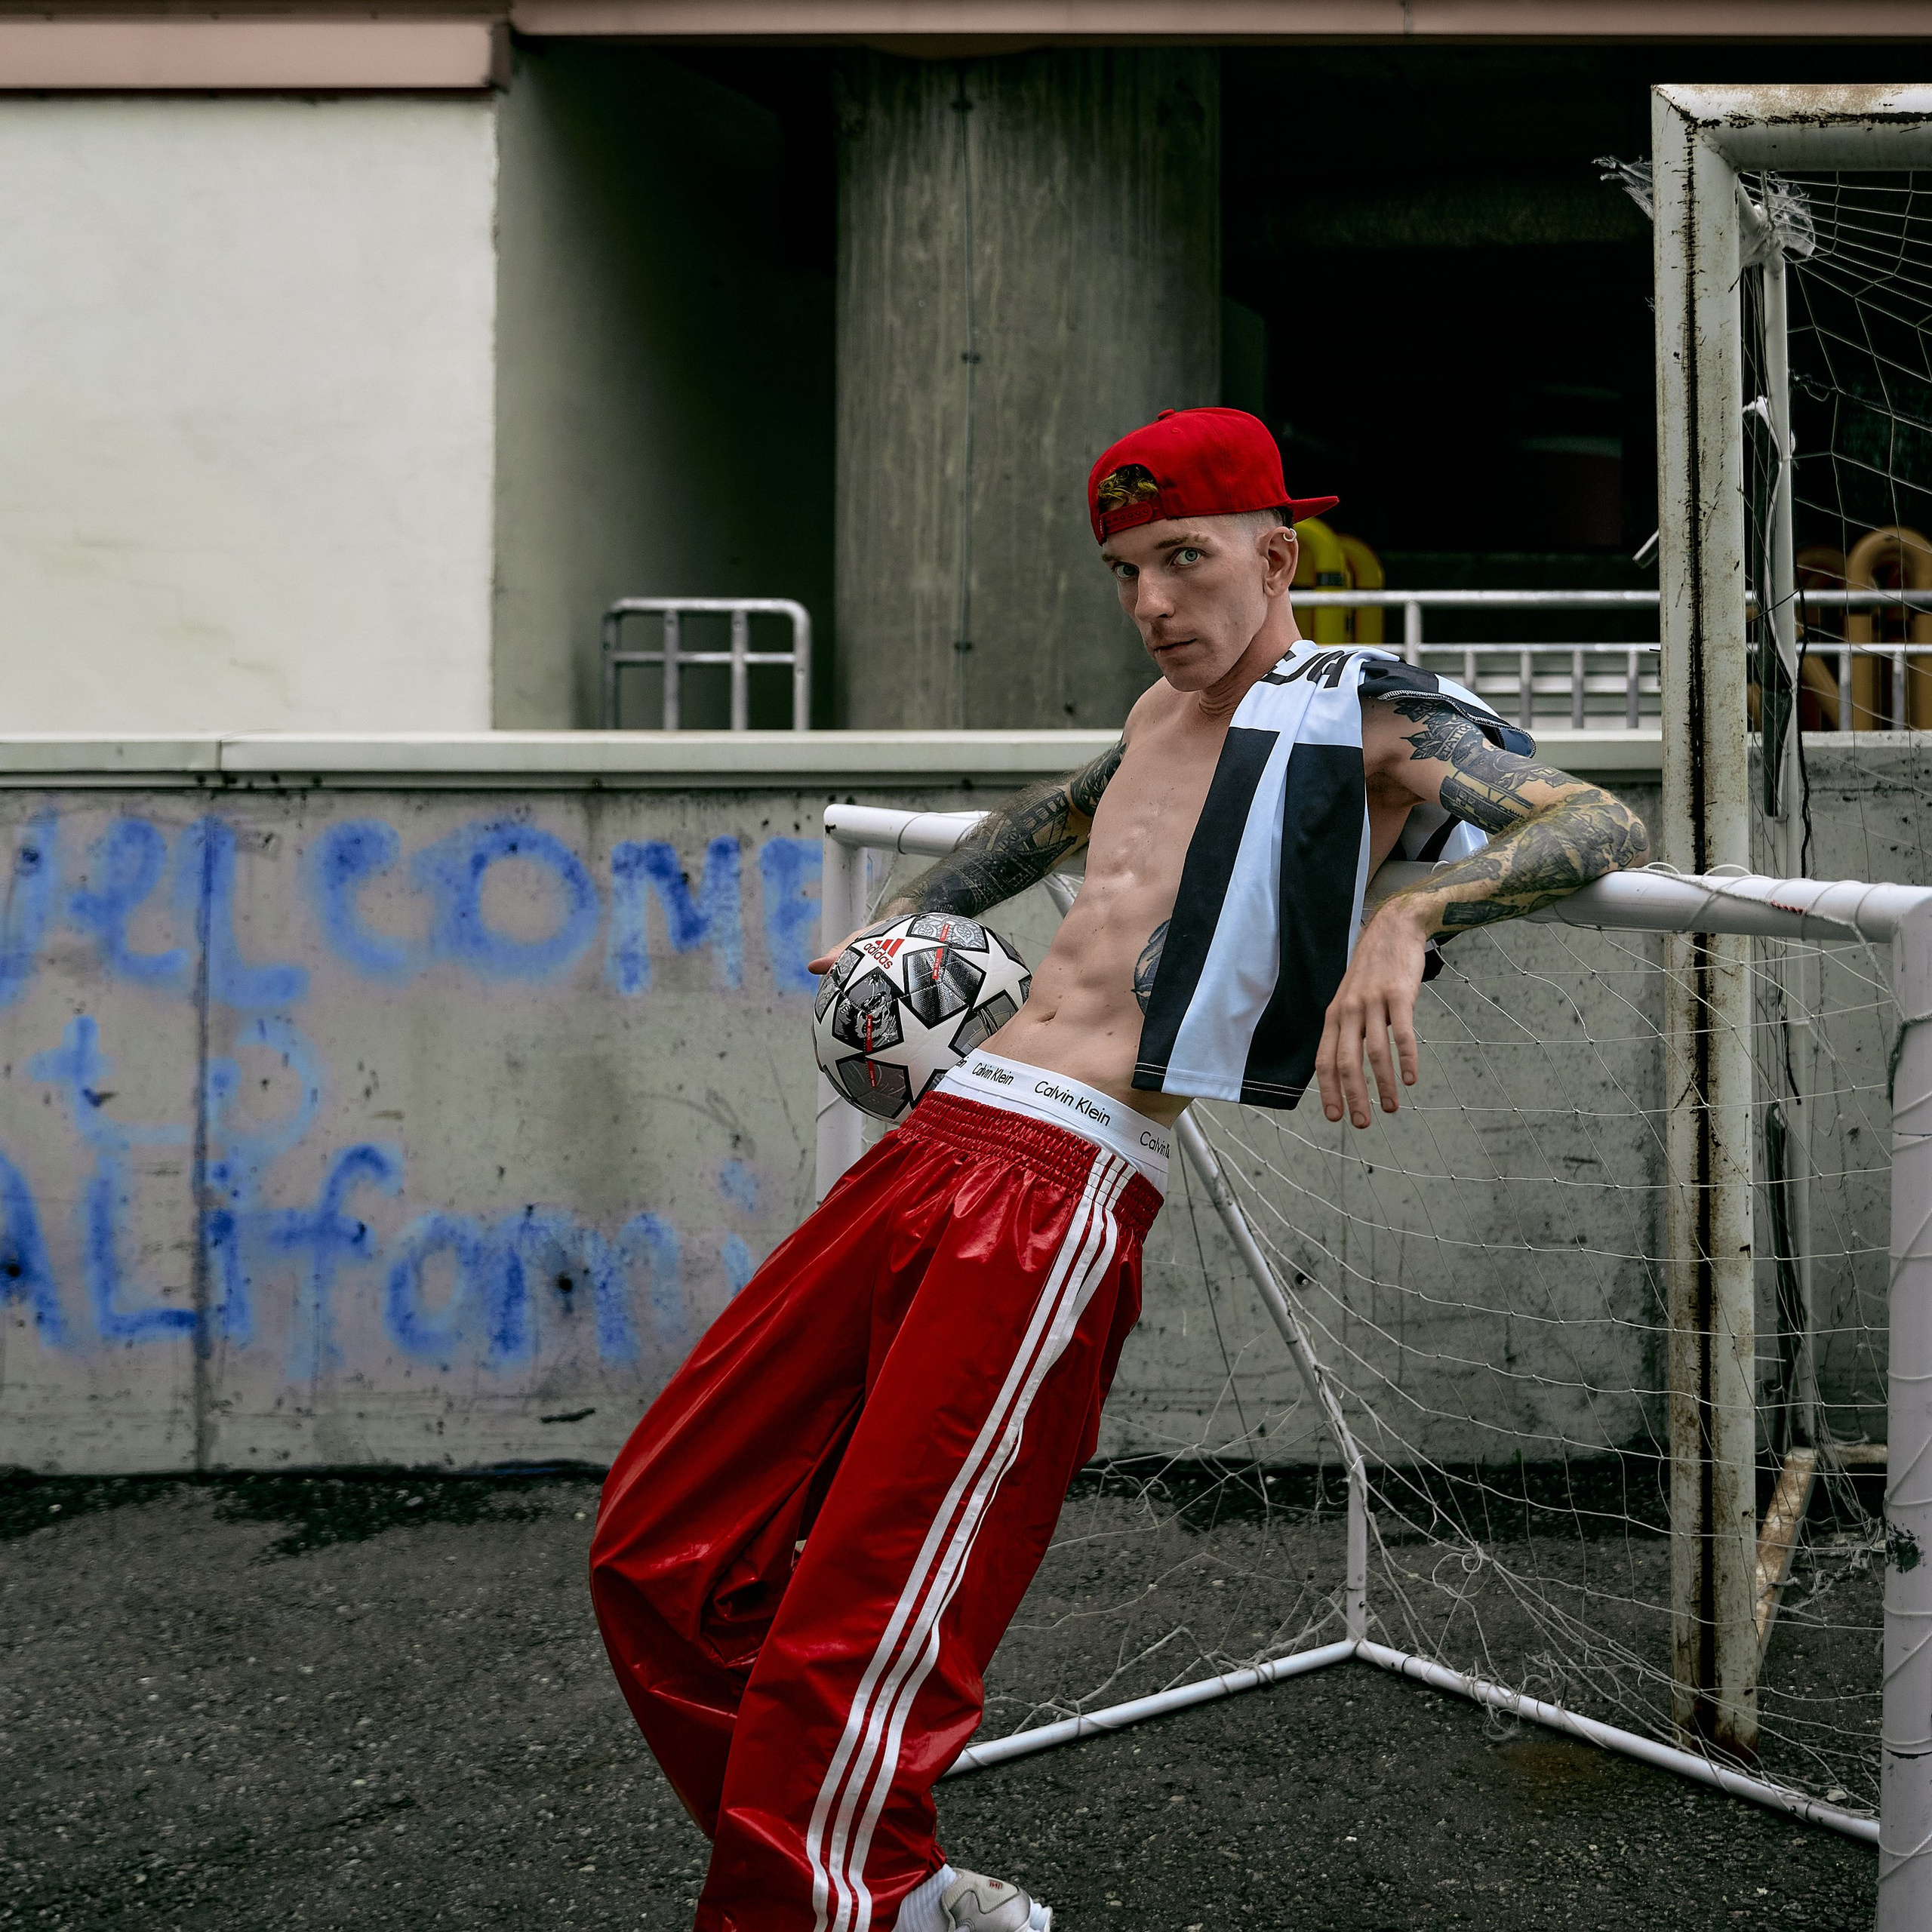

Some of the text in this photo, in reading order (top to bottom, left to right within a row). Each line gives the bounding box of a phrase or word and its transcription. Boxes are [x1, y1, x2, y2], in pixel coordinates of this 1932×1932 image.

[1440, 724, 1473, 755] TATTOO
[863, 943, 893, 970] adidas
[972, 1063, 993, 1079] Calvin
[990, 1068, 1014, 1085] Klein
[1035, 1081, 1075, 1106] Calvin
[1075, 1097, 1111, 1126] Klein
[1140, 1131, 1166, 1156] Calvin
